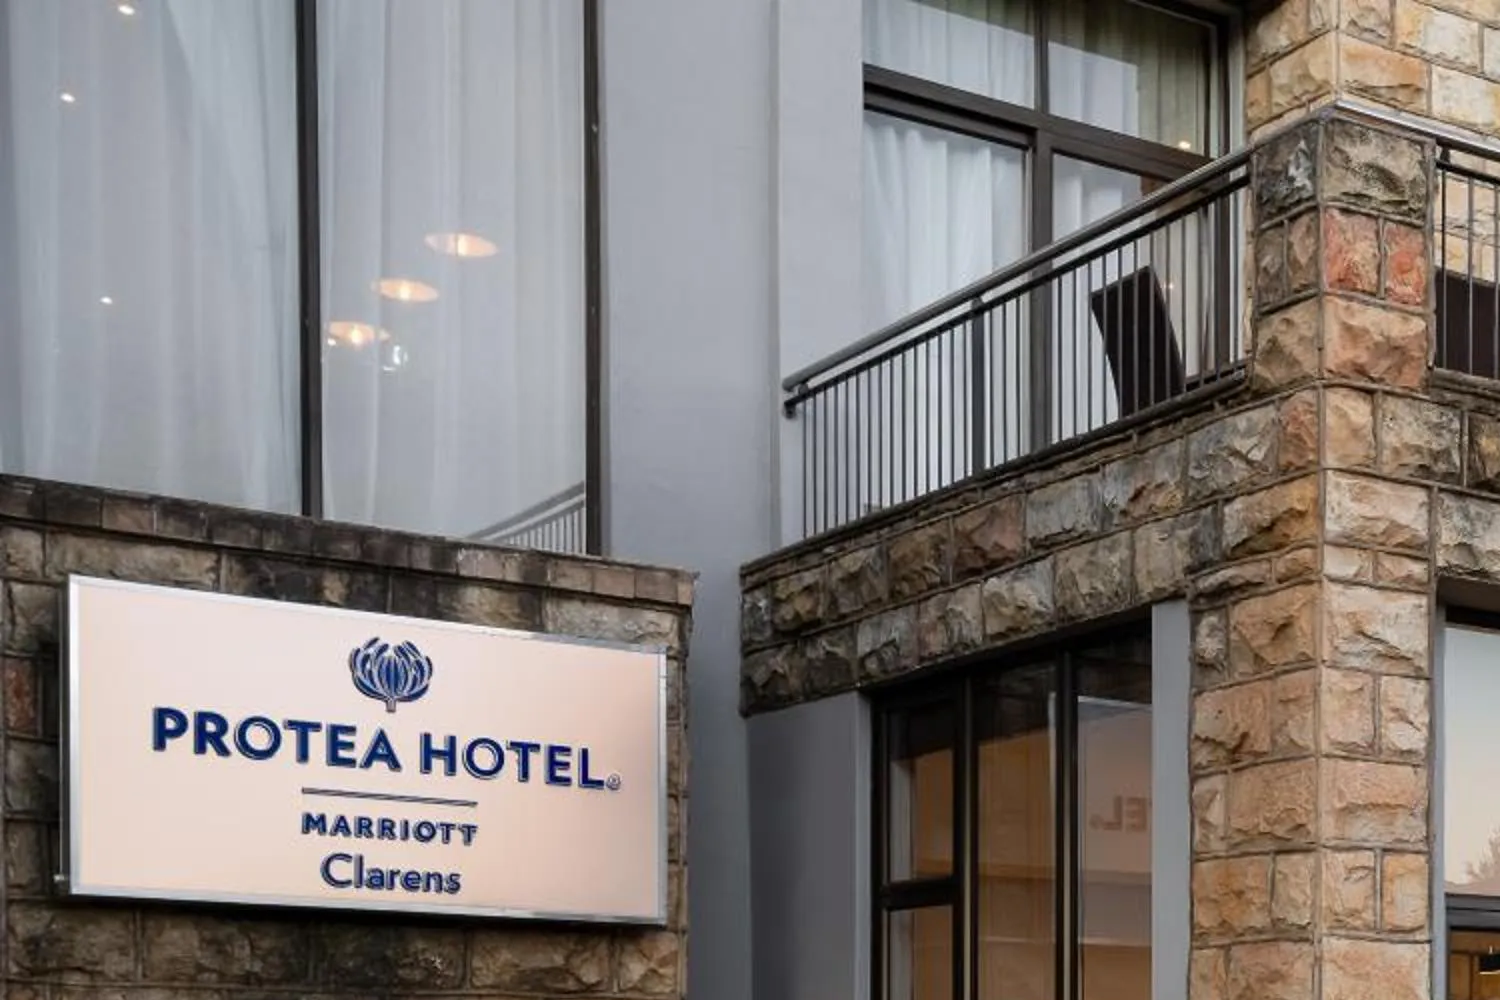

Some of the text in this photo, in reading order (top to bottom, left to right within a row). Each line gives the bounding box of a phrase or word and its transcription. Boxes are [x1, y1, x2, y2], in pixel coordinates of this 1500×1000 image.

[152, 706, 402, 773] PROTEA
[301, 812, 478, 846] MARRIOTT
[319, 852, 462, 895] Clarens
